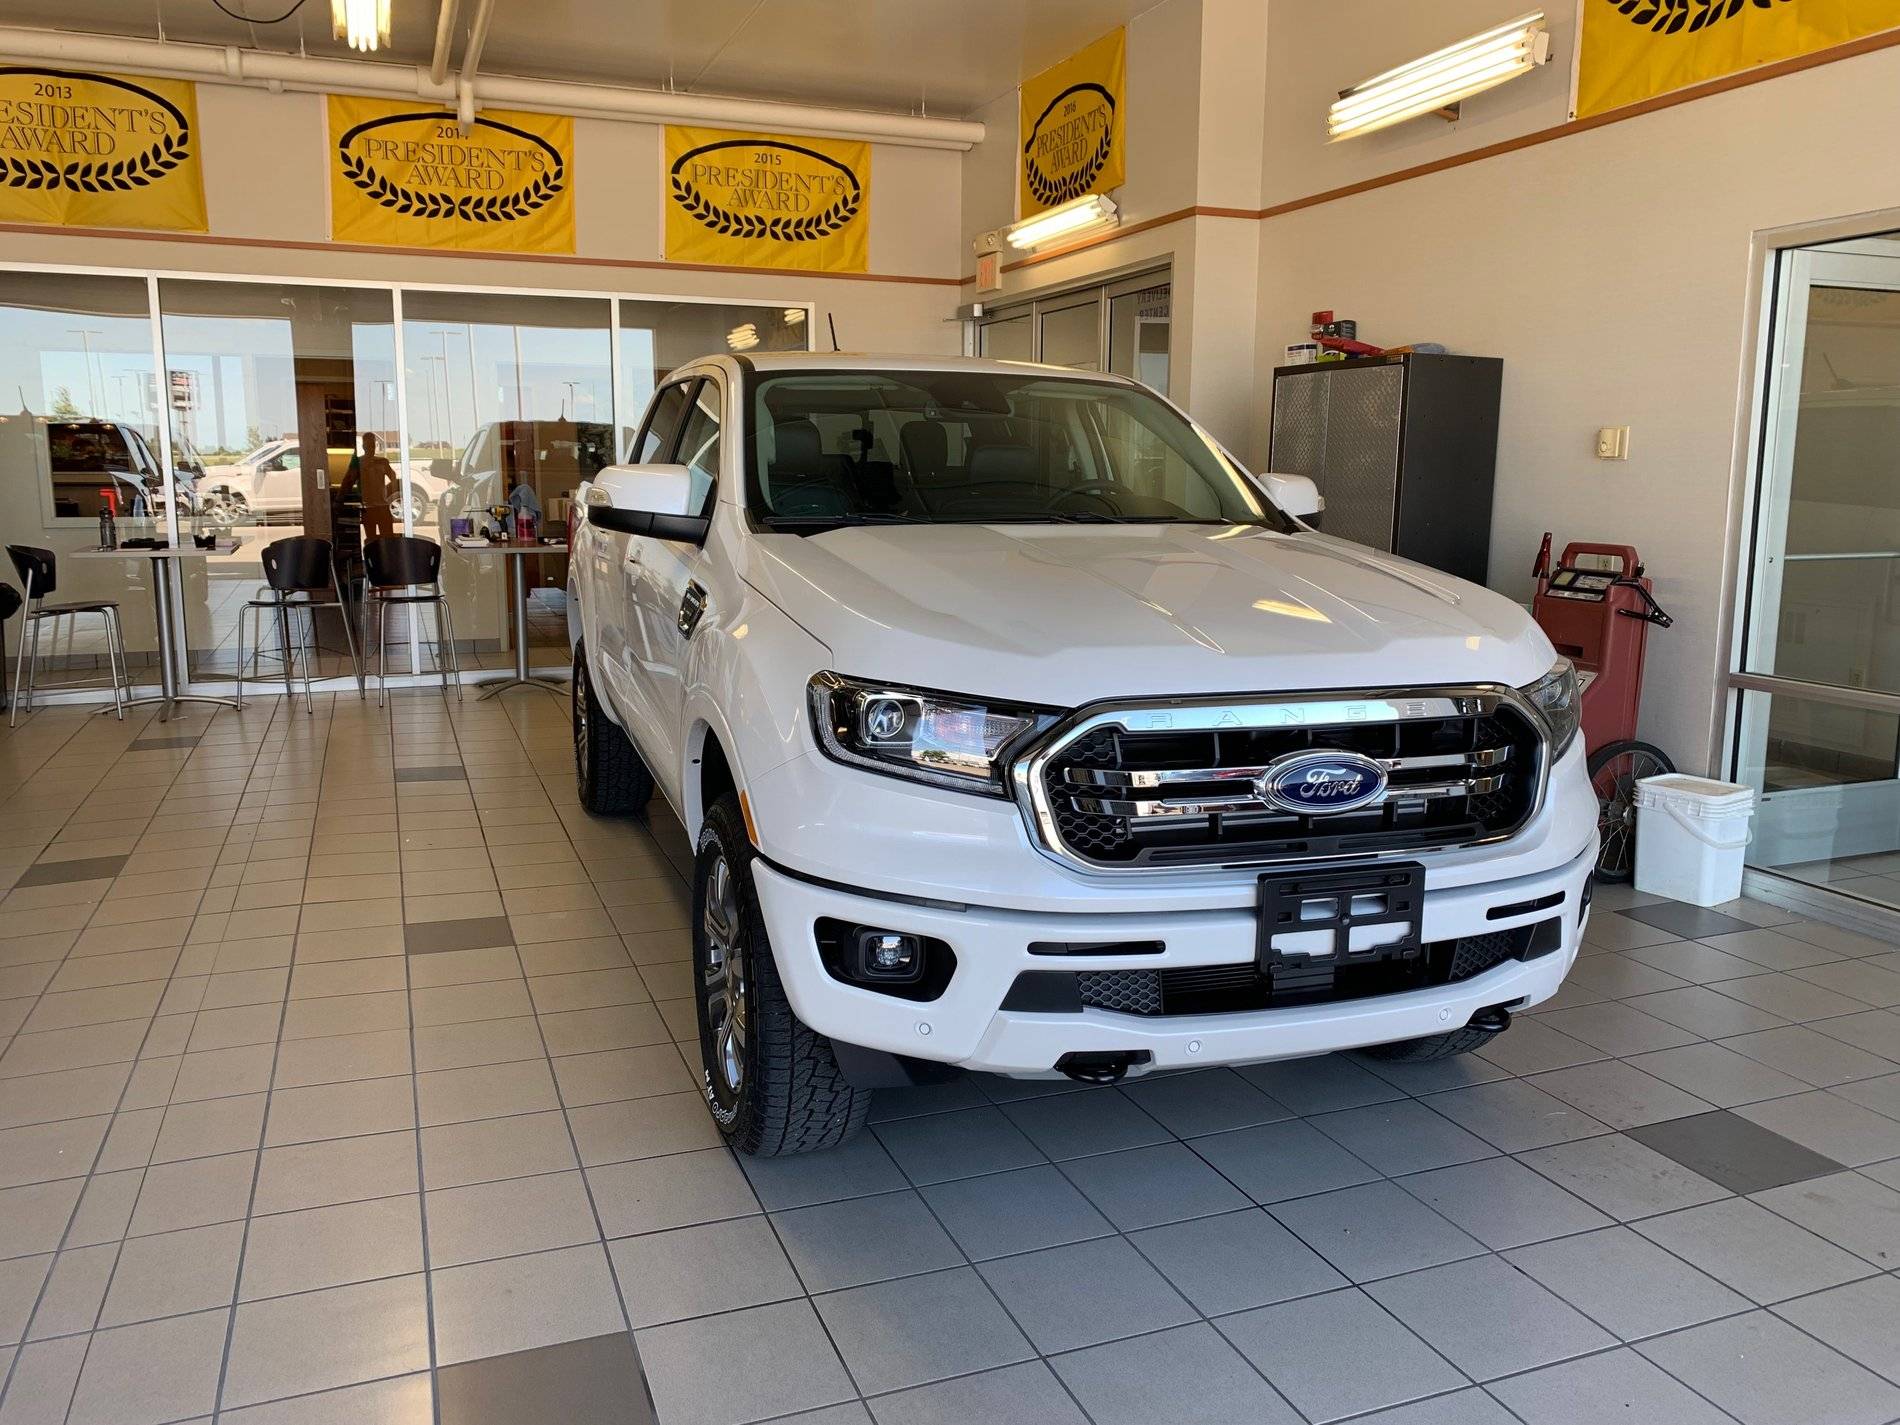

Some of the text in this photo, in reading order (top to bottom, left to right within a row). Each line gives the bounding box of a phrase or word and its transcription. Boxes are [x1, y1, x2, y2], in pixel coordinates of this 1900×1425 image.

[34, 83, 72, 99] 2013
[0, 126, 116, 155] AWARD
[1036, 103, 1107, 158] PRESIDENT'S
[364, 138, 546, 172] PRESIDENT'S
[754, 152, 782, 166] 2015
[1050, 138, 1088, 174] AWARD
[405, 164, 505, 191] AWARD
[691, 163, 846, 196] PRESIDENT'S
[727, 188, 810, 212] AWARD
[1300, 768, 1363, 798] Ford
